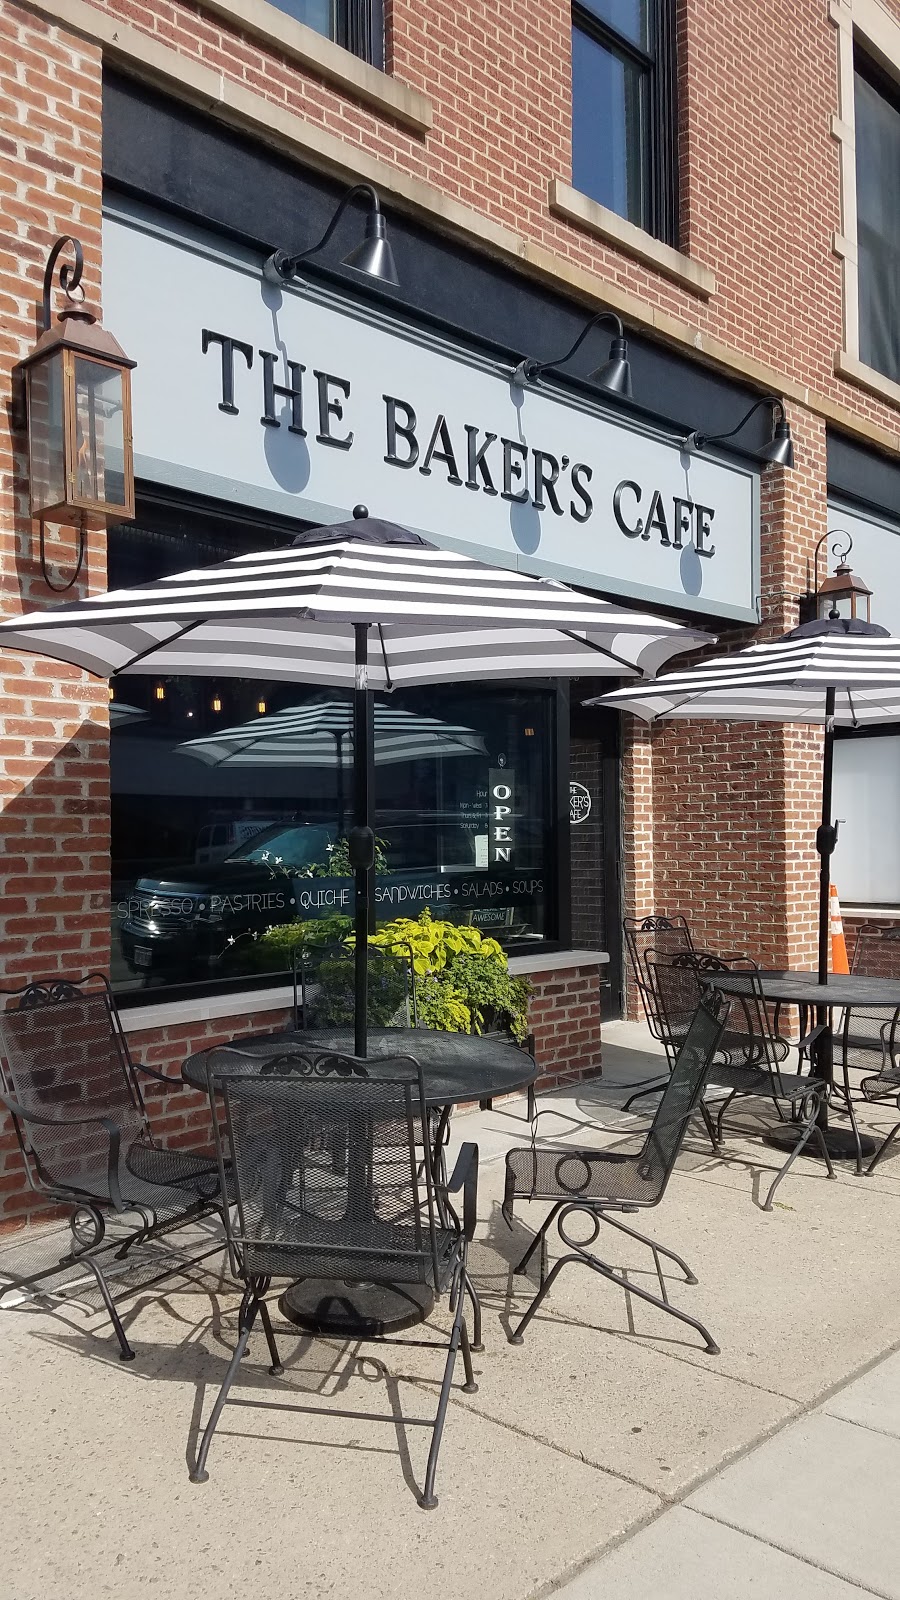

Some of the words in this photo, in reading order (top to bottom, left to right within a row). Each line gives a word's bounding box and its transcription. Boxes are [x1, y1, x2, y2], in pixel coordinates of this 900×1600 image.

[201, 328, 354, 452] THE
[382, 394, 594, 524] BAKER'S
[613, 479, 716, 559] CAFE
[493, 784, 513, 862] OPEN
[210, 892, 285, 915] PASTRIES
[300, 888, 351, 910] QUICHE
[374, 883, 452, 904] SANDWICHES
[461, 881, 504, 898] SALADS
[512, 879, 544, 895] SOUPS
[472, 911, 506, 922] AWESOME
